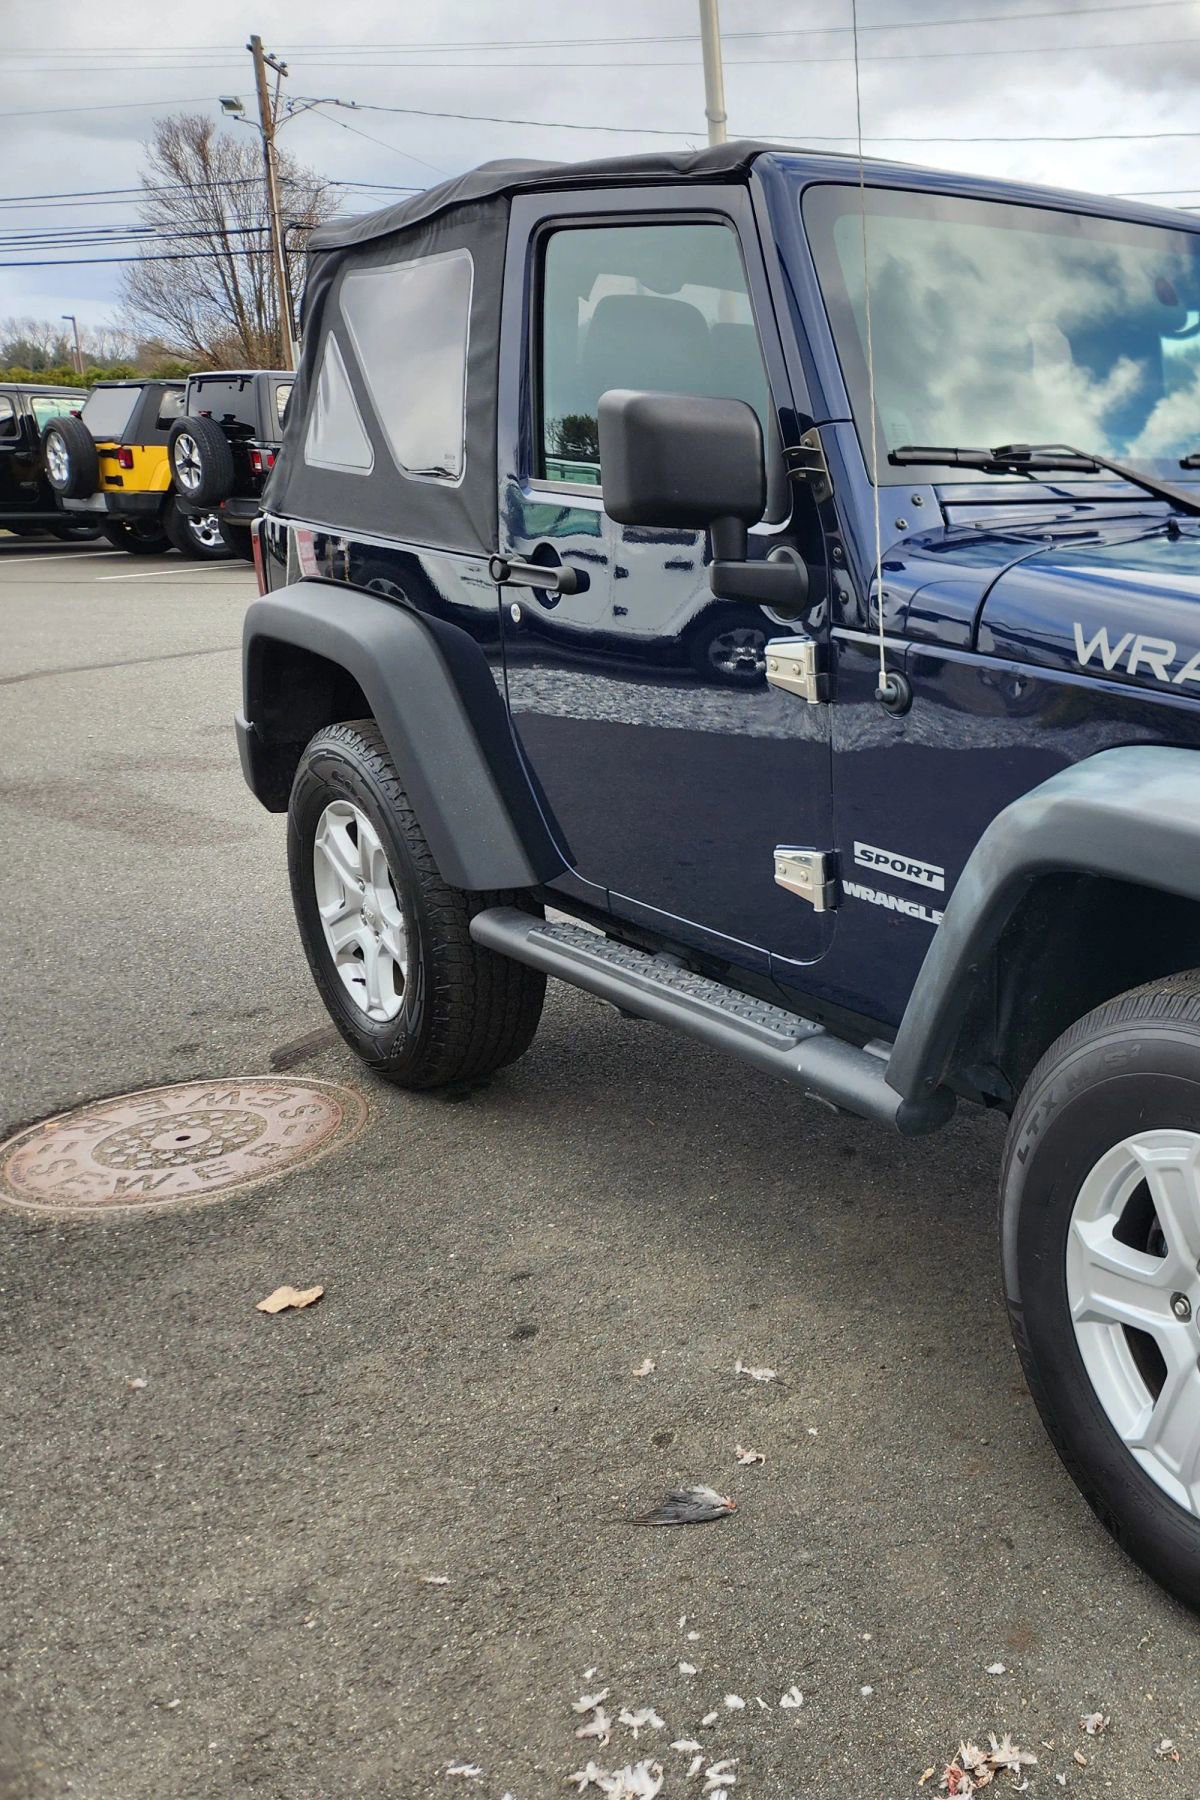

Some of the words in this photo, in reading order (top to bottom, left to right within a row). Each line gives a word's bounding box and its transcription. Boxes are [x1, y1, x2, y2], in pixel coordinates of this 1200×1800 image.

[854, 848, 944, 883] SPORT
[842, 880, 944, 925] WRANGLE
[1017, 1090, 1058, 1165] LTX
